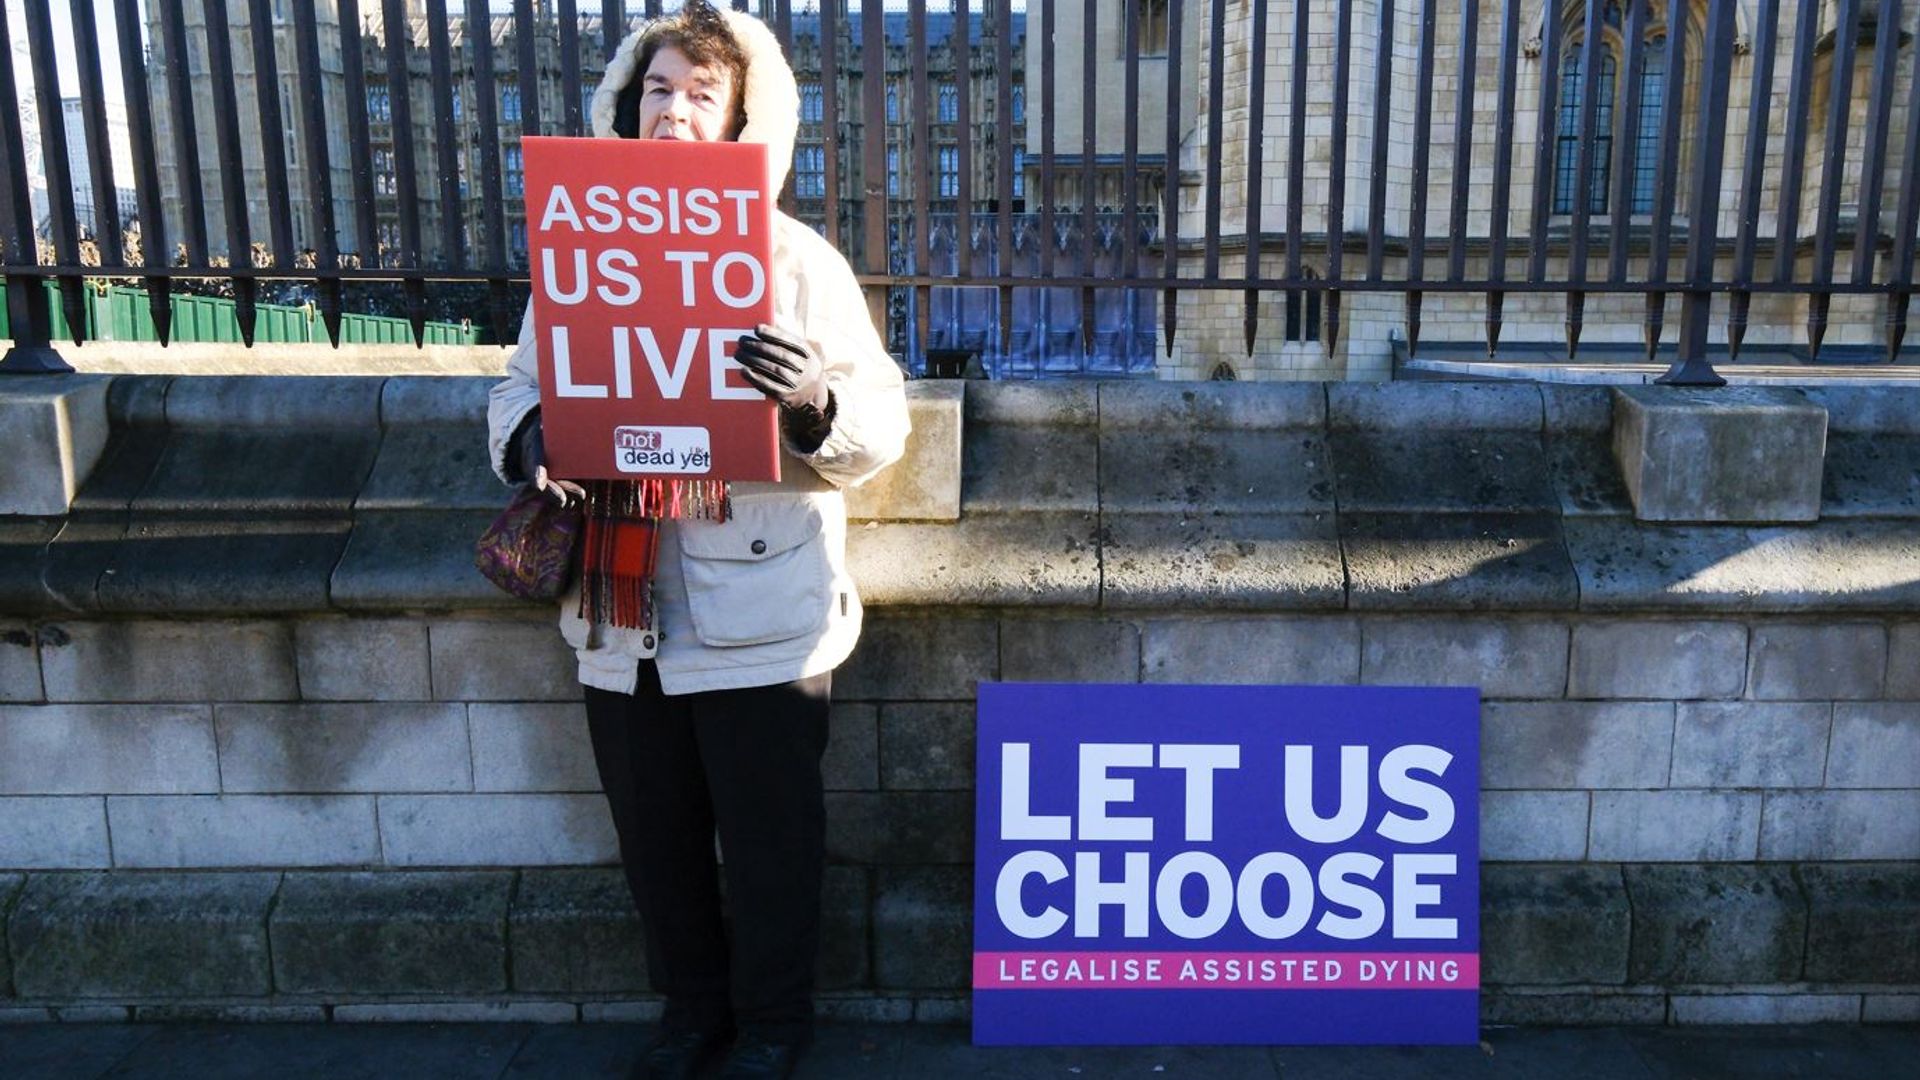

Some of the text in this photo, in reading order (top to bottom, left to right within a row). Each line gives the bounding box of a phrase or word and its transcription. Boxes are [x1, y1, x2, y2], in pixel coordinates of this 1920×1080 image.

[540, 184, 760, 236] ASSIST
[542, 248, 765, 308] US TO
[551, 326, 766, 401] LIVE
[622, 432, 656, 449] not
[624, 447, 710, 470] dead yet
[1000, 742, 1456, 844] LET US
[995, 850, 1459, 939] CHOOSE
[999, 959, 1460, 982] LEGALISE ASSISTED DYING
